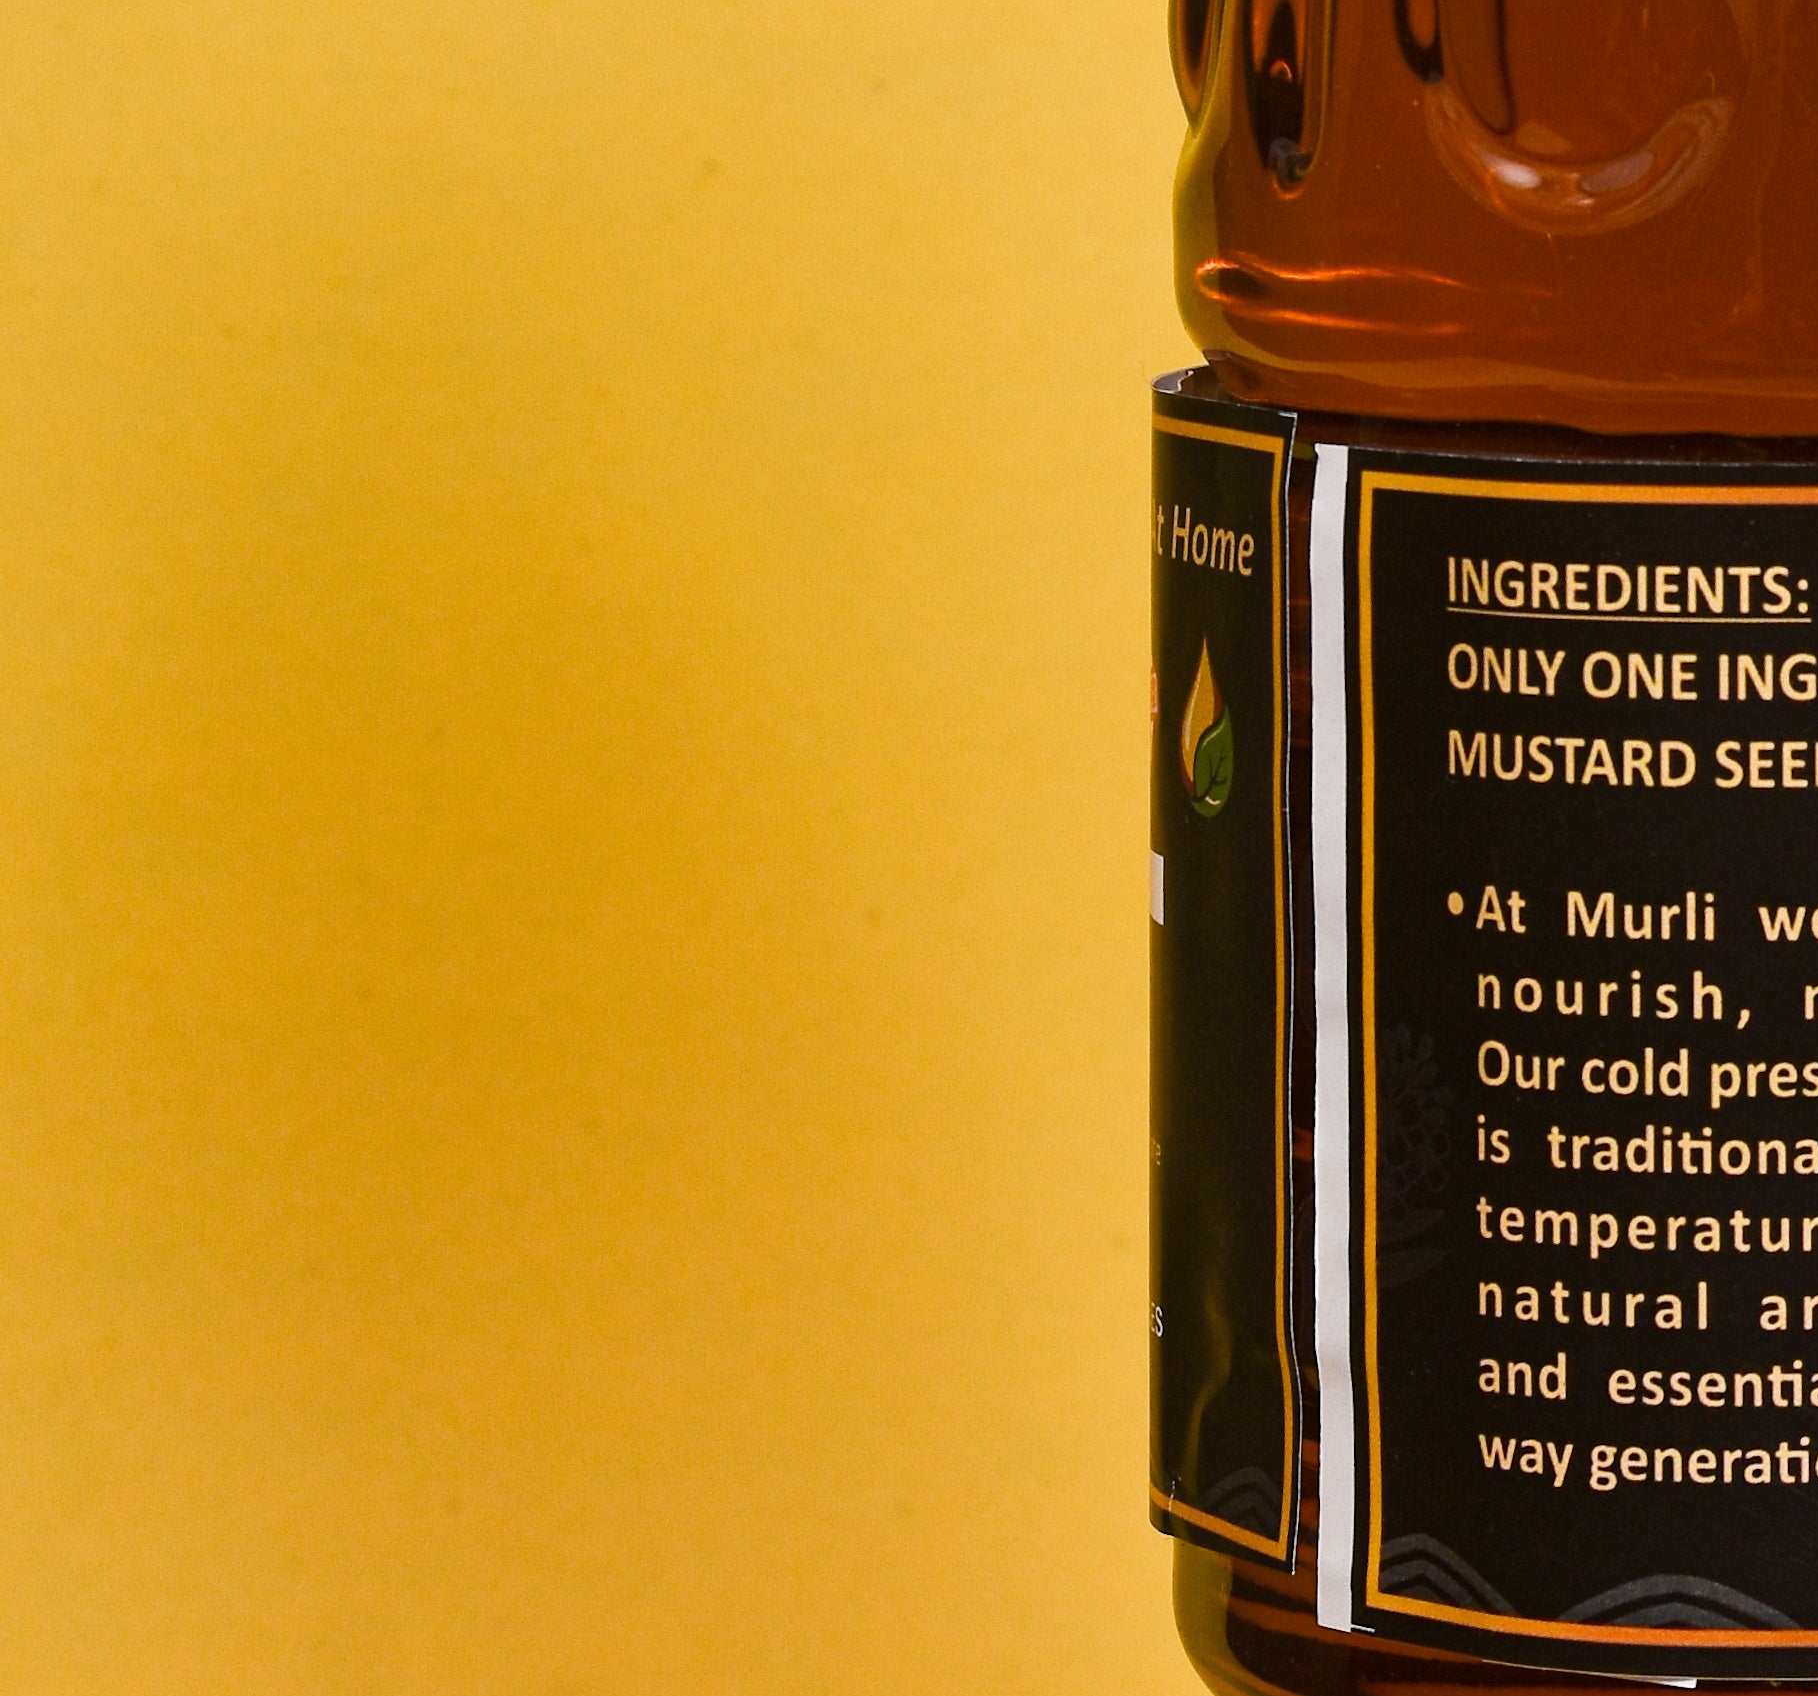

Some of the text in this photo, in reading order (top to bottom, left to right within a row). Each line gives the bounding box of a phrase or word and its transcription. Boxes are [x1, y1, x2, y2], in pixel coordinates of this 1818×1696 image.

[1170, 504, 1256, 577] Home
[1446, 555, 1813, 622] INGREDIENTS:
[1446, 641, 1567, 698] ONLY
[1581, 649, 1699, 702] ONE
[1447, 728, 1698, 789] MUSTARD
[1474, 884, 1528, 935] At
[1566, 889, 1716, 943] Murli
[1477, 968, 1752, 1031] nourish,
[1476, 1039, 1567, 1092] Our
[1580, 1045, 1690, 1098] cold
[1476, 1113, 1512, 1165] is
[1478, 1279, 1709, 1331] natural
[1477, 1350, 1568, 1401] and
[1477, 1432, 1575, 1489] way
